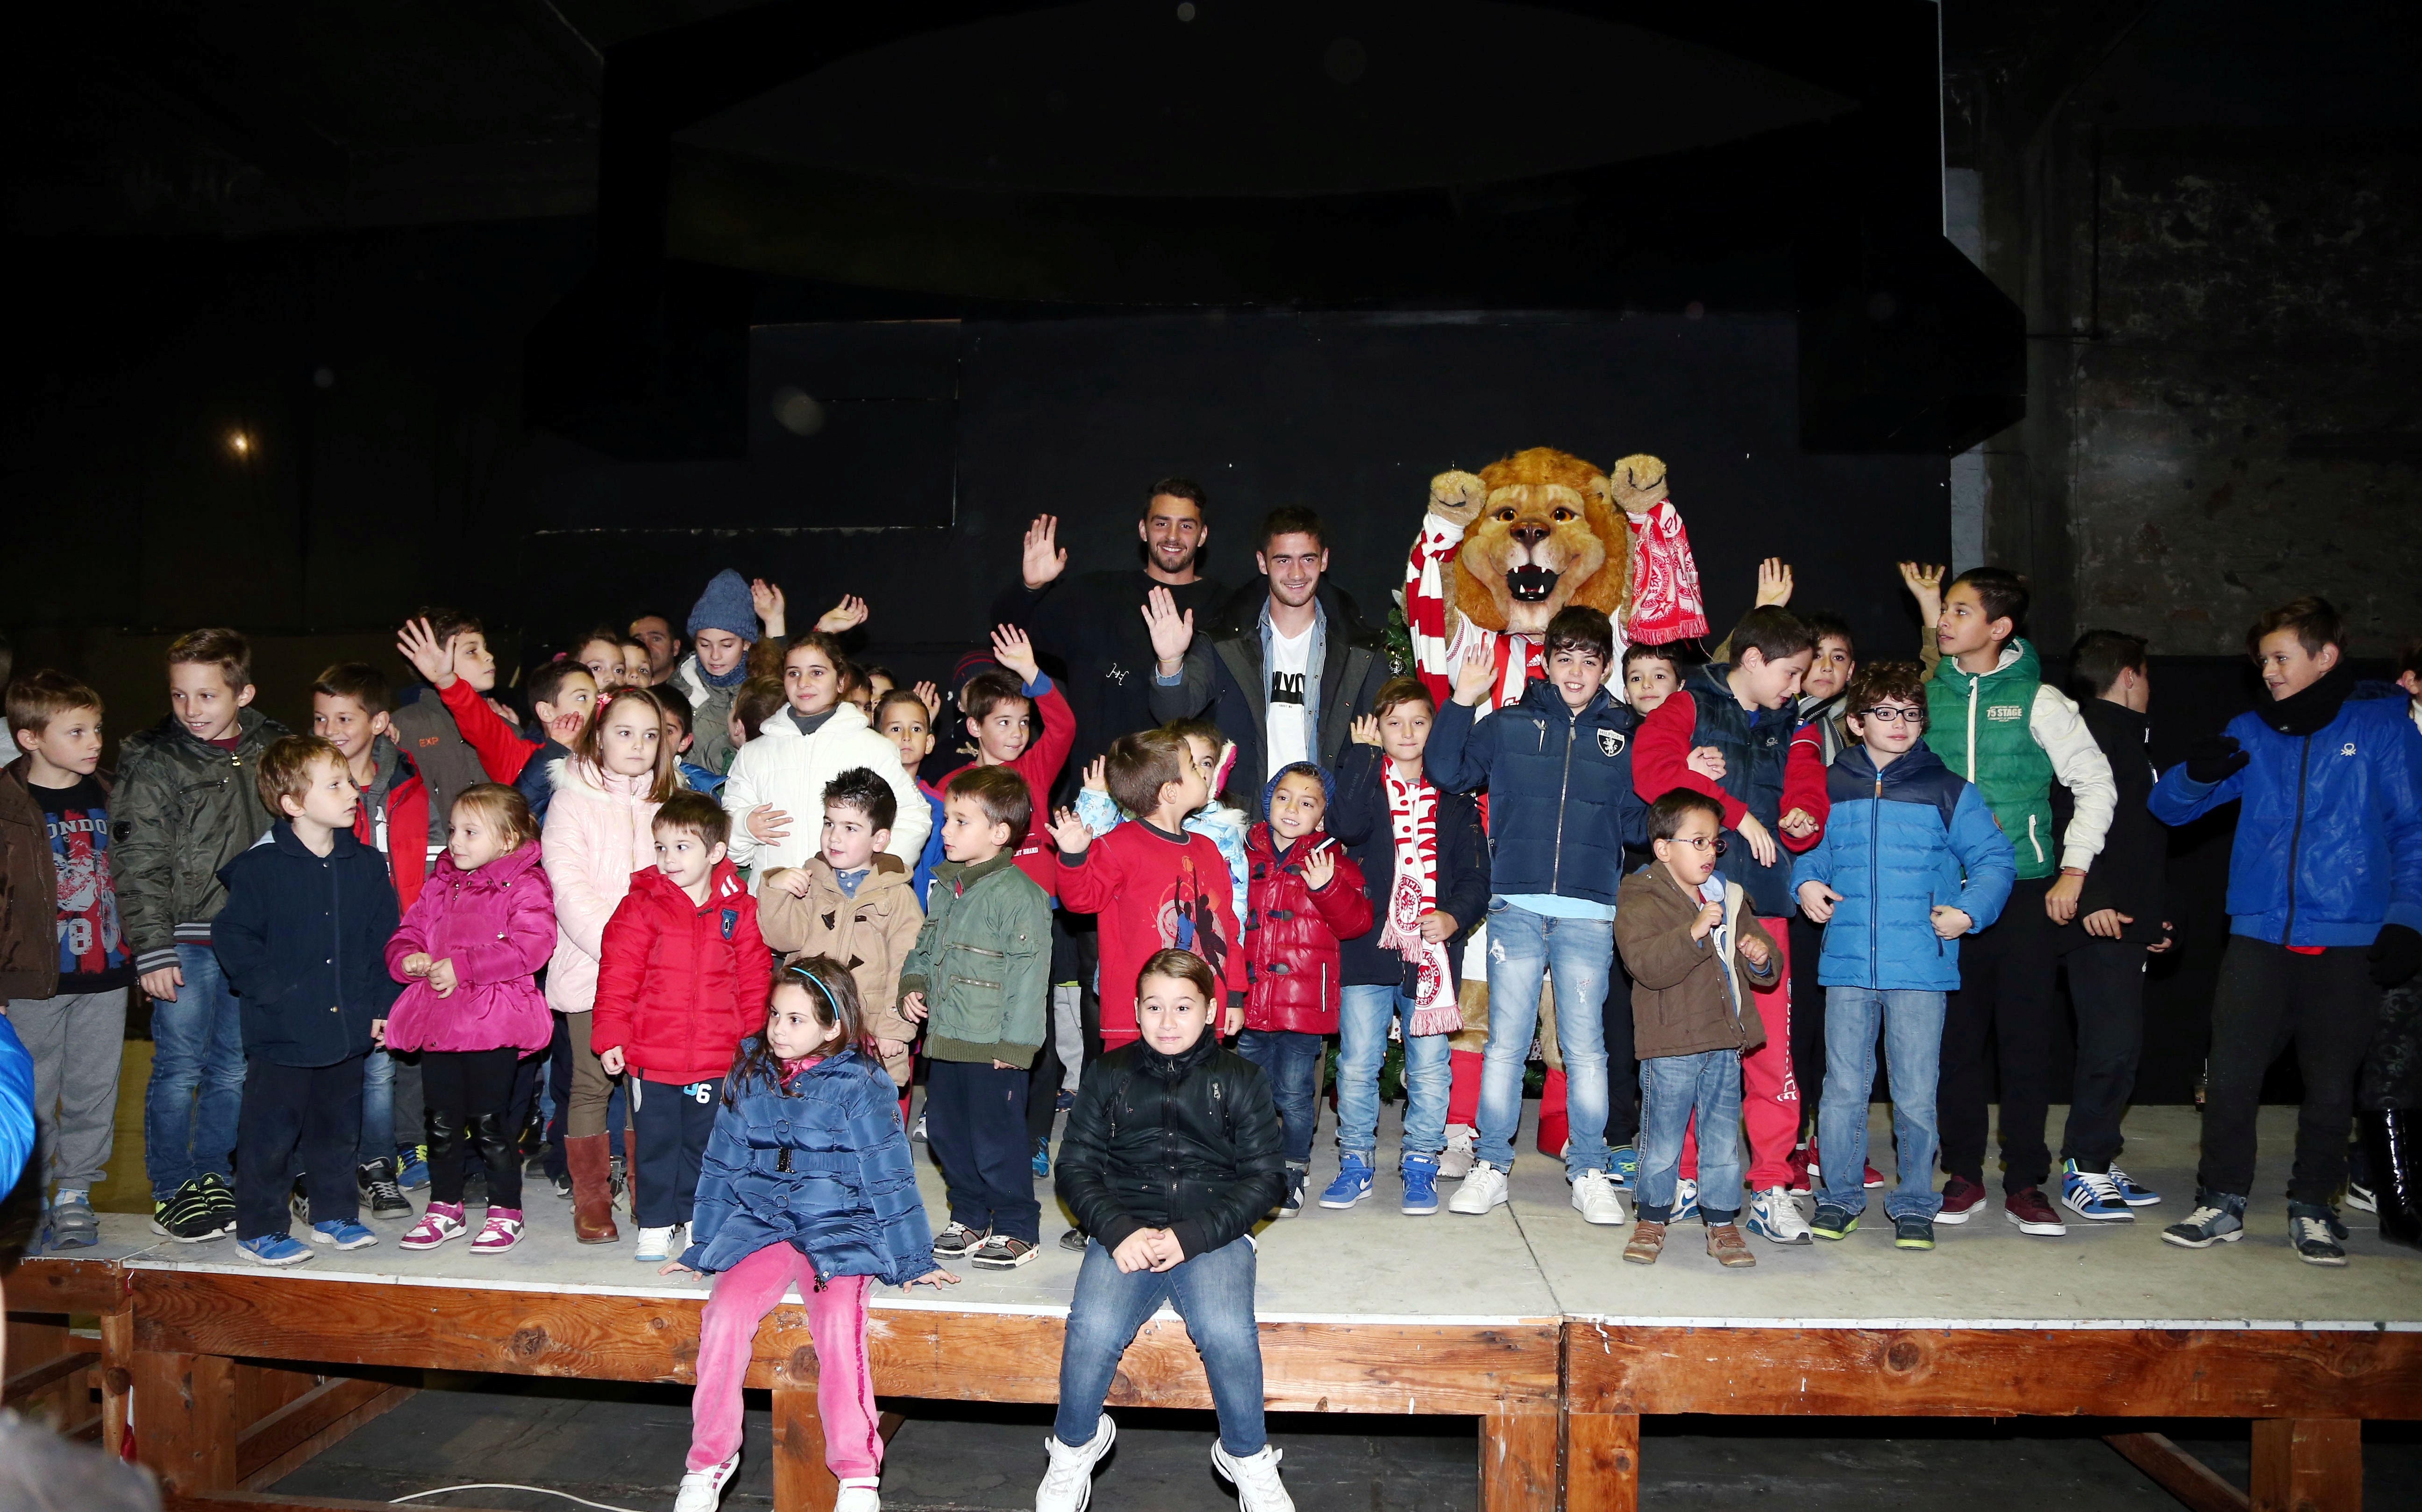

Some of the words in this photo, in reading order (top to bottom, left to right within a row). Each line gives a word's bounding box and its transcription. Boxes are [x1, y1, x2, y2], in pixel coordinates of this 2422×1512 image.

[1997, 708, 2023, 717] STAGE
[1599, 730, 1624, 740] HILFIGER
[419, 737, 439, 747] EXP
[47, 819, 107, 839] ONDO
[1023, 847, 1038, 855] BRAND
